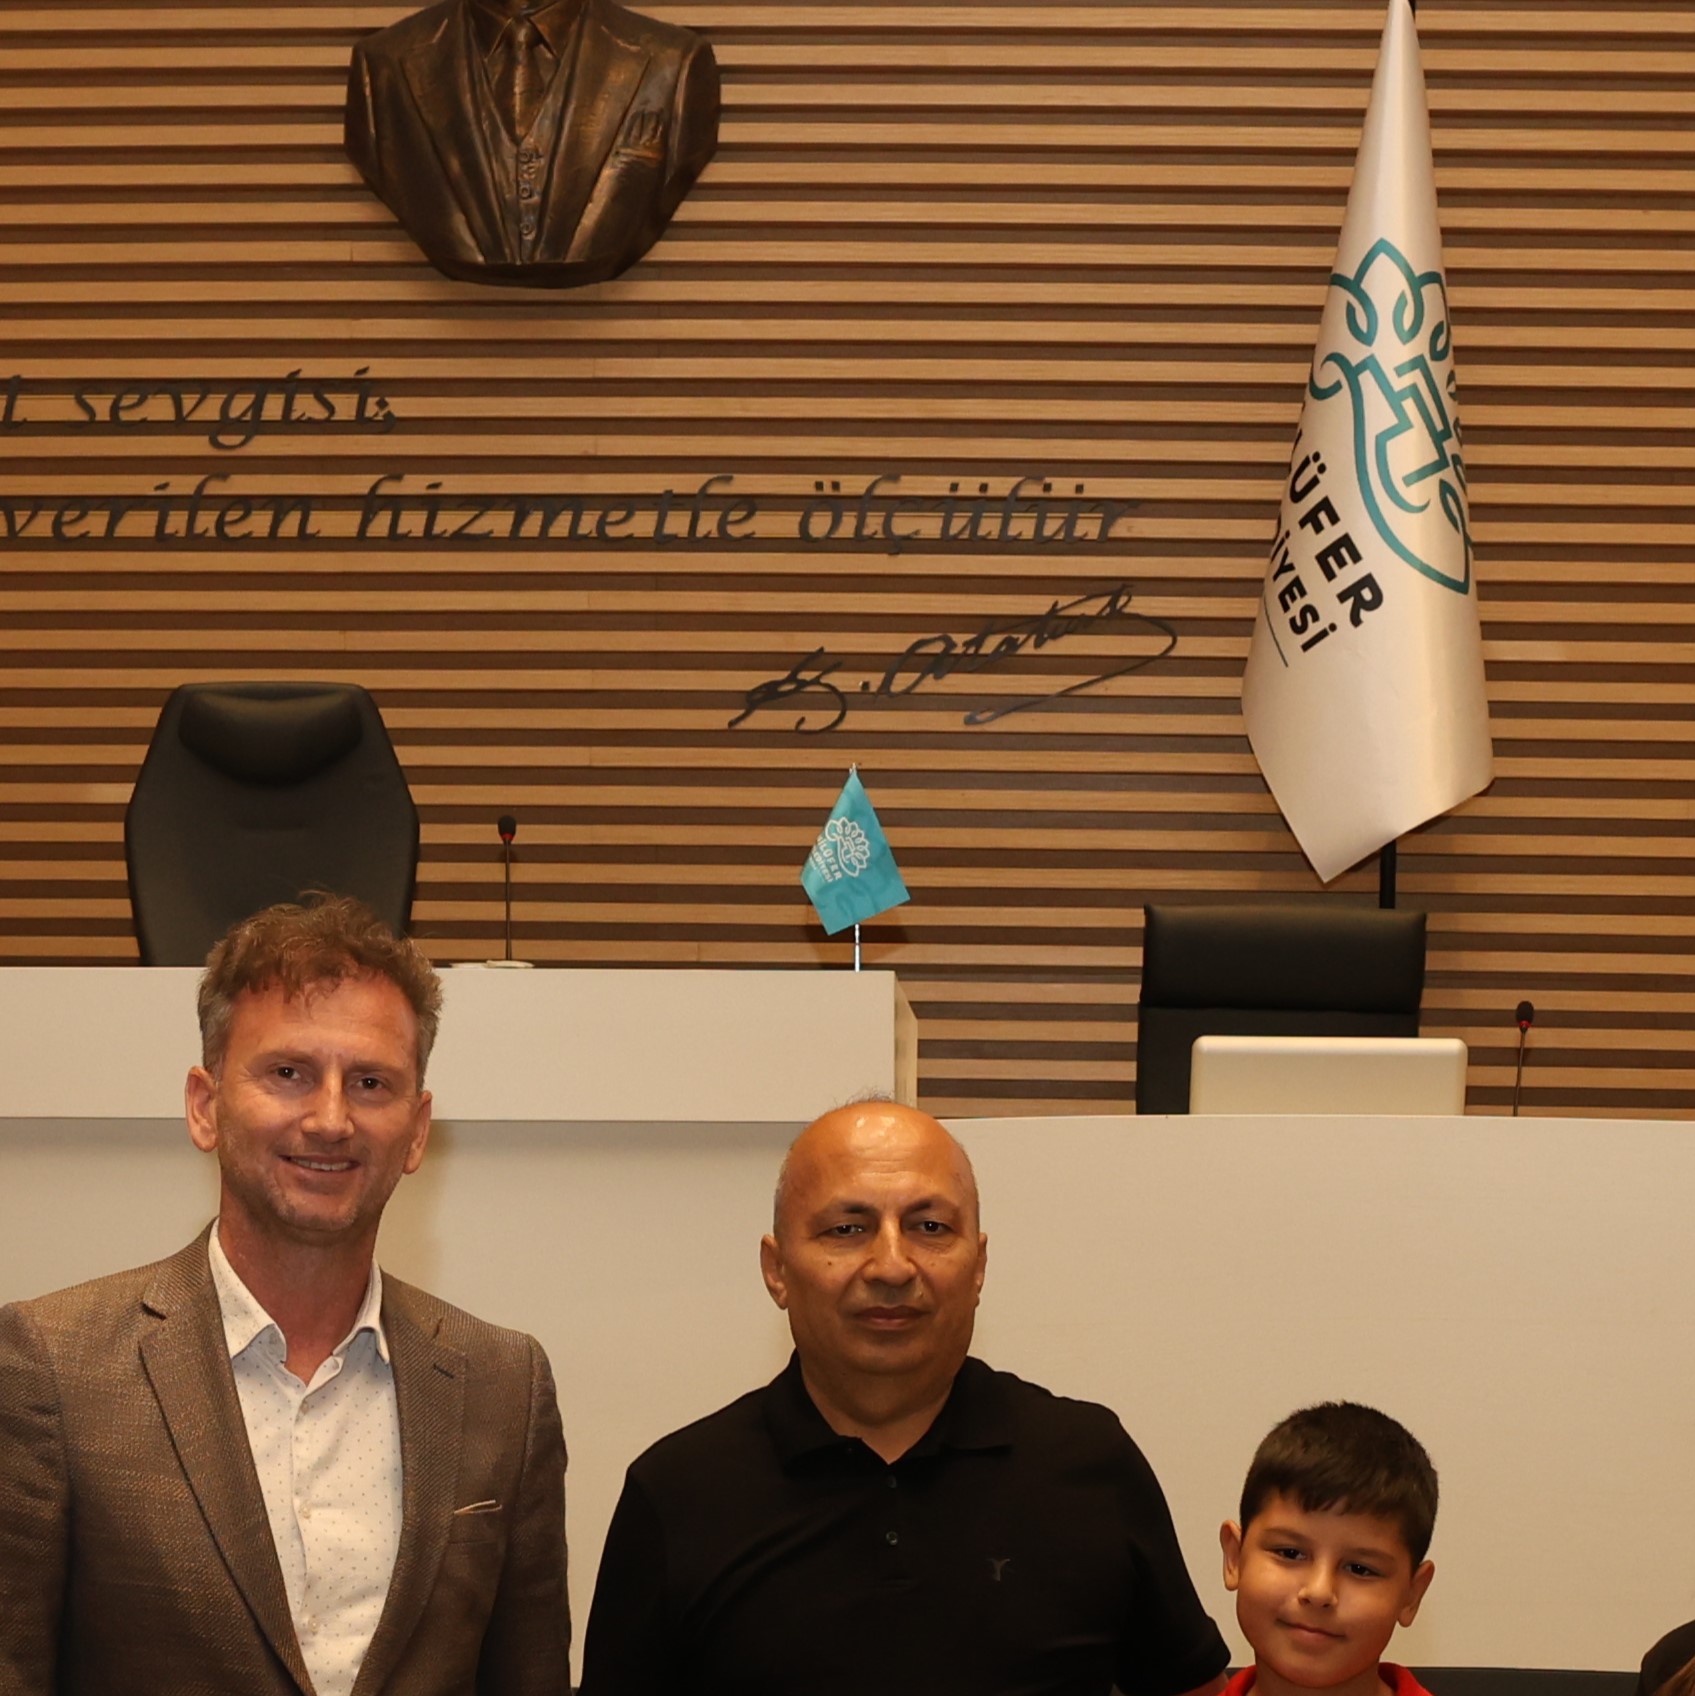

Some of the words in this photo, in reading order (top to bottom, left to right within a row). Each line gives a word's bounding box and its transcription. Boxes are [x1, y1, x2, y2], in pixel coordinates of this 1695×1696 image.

[350, 473, 758, 544] hizmetle
[797, 474, 1139, 556] ölçülür
[1288, 440, 1384, 629] ÜFER
[1270, 522, 1337, 653] İYESİ
